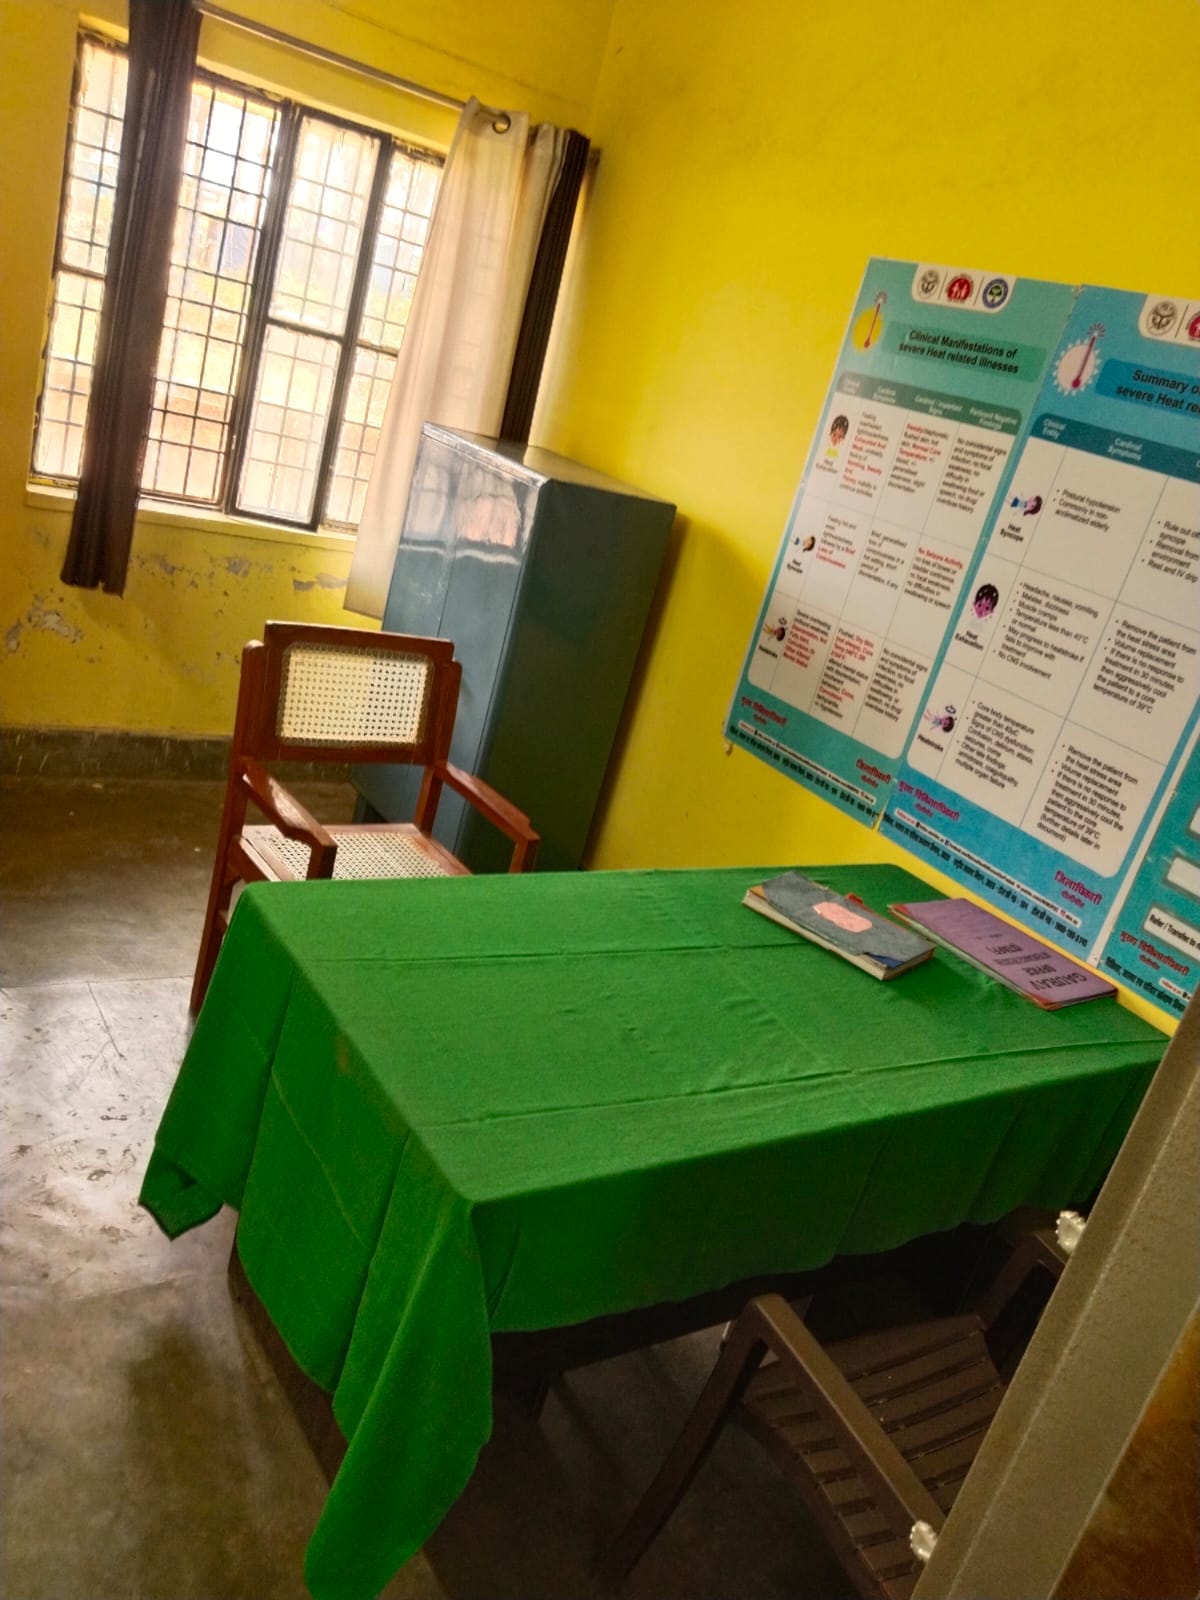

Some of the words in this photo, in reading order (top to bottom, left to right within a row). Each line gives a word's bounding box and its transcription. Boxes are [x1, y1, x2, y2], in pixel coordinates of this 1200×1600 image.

[897, 342, 925, 355] severe
[925, 345, 947, 359] Heat
[945, 349, 978, 365] related
[977, 355, 1021, 374] illnesses
[908, 329, 941, 345] Clinical
[939, 335, 1006, 358] Manifestations
[1004, 347, 1018, 360] of
[1116, 384, 1154, 403] severe
[1156, 393, 1185, 411] Heat
[1132, 369, 1188, 395] Summary
[1115, 629, 1127, 638] the
[1126, 633, 1142, 644] heat
[1140, 639, 1161, 652] stress
[1160, 647, 1176, 658] area
[1120, 620, 1148, 636] Remove
[1146, 630, 1159, 640] the
[1157, 634, 1182, 650] patient
[1180, 643, 1198, 655] from
[1112, 638, 1137, 653] Volume
[1135, 647, 1176, 670] replacement
[1060, 762, 1082, 778] Volume
[1081, 773, 1119, 798] replacement
[1065, 754, 1076, 764] the
[1075, 759, 1090, 771] heat
[1088, 766, 1108, 780] stress
[1106, 776, 1122, 788] area
[1067, 745, 1092, 762] Remove
[1091, 757, 1103, 768] the
[1101, 762, 1124, 779] patient
[1122, 773, 1138, 785] from
[1061, 773, 1078, 786] there
[1090, 789, 1119, 809] response
[1046, 796, 1067, 812] patient
[1072, 810, 1084, 820] the
[1082, 816, 1097, 828] core
[1050, 788, 1065, 799] then
[1063, 795, 1100, 820] aggressively
[1099, 814, 1113, 825] cool
[1112, 821, 1124, 831] the
[1148, 913, 1166, 928] Refer
[1166, 923, 1190, 943] Transfer
[1029, 972, 1088, 991] GAURAV
